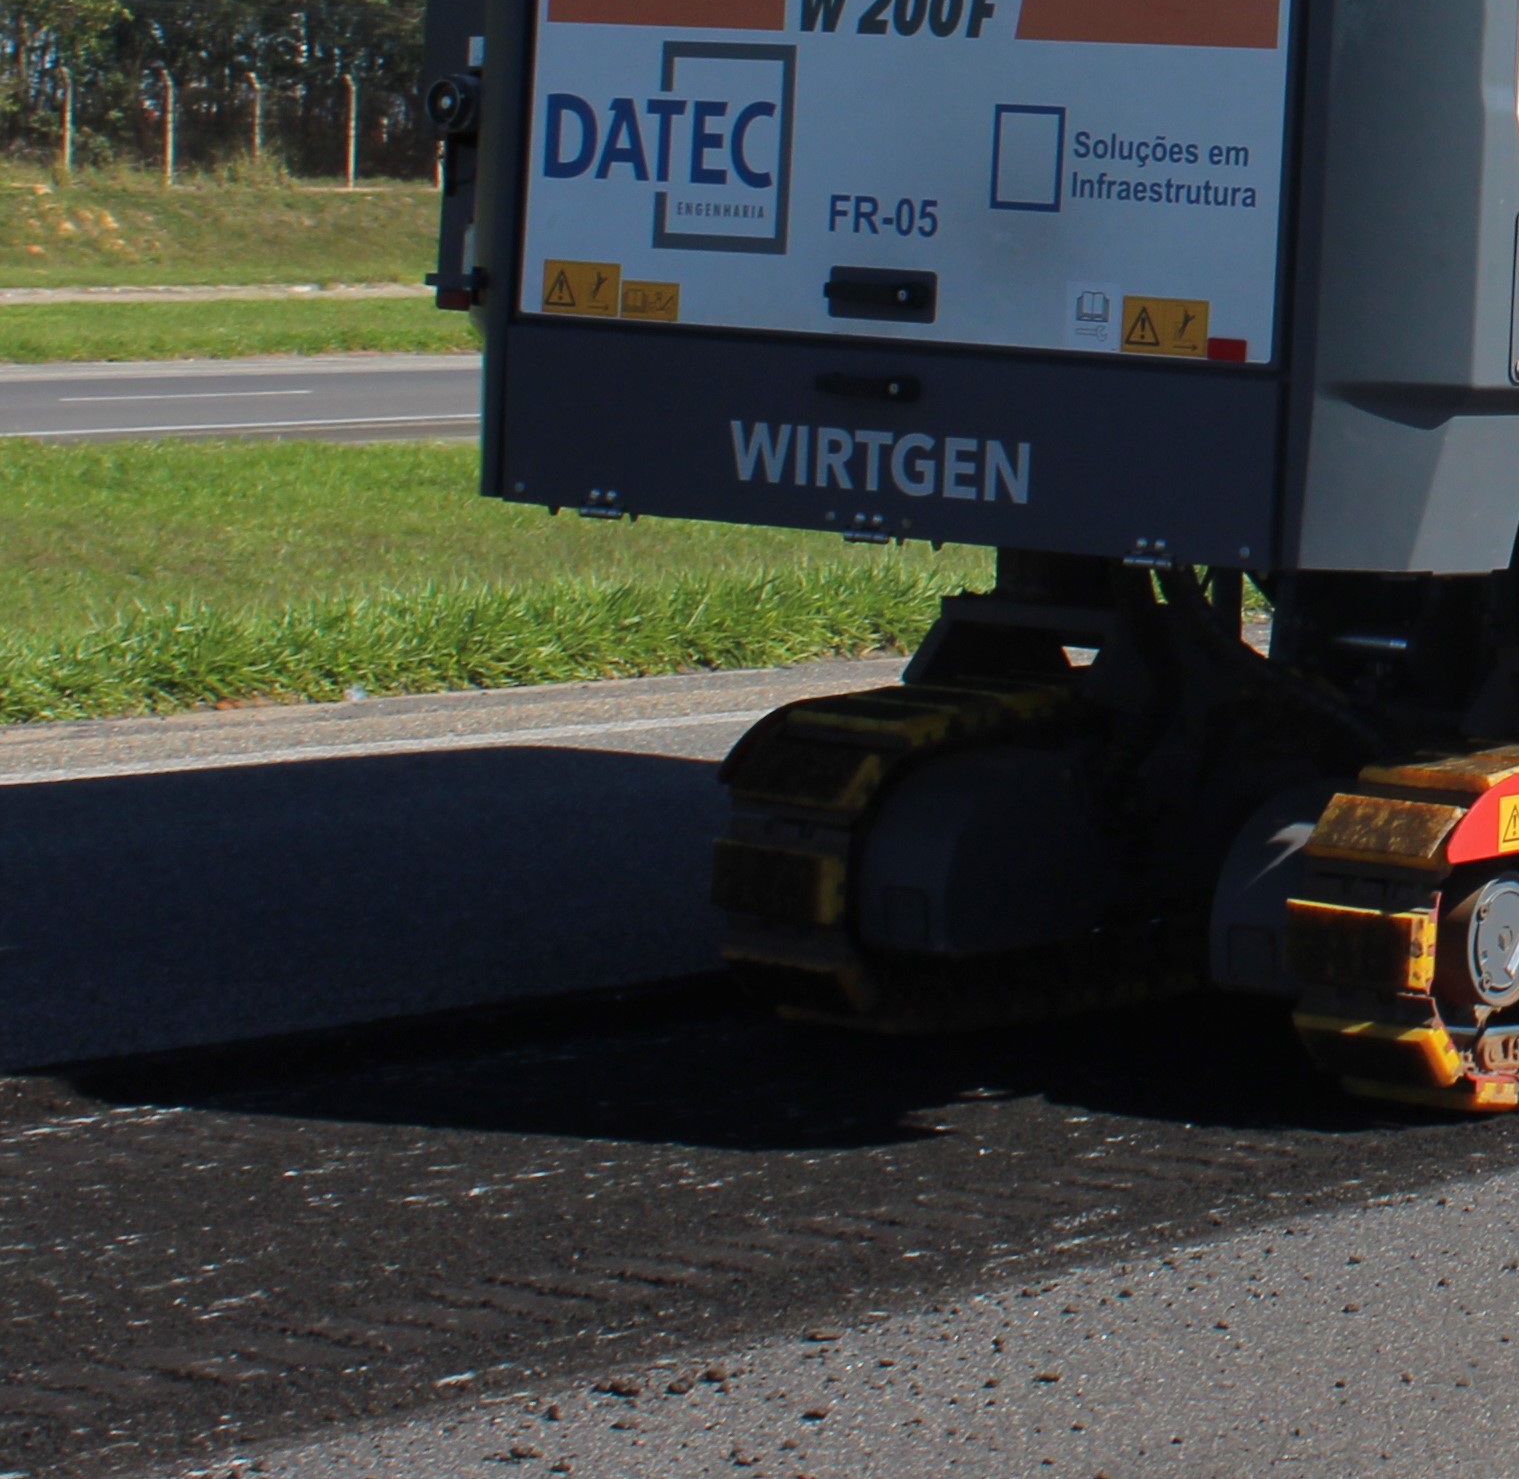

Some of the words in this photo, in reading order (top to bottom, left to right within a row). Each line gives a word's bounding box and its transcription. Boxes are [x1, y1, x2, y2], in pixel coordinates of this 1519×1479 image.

[543, 93, 777, 189] DATEC
[1073, 131, 1199, 168] Soluções
[1208, 144, 1249, 167] em
[1071, 171, 1257, 208] Infraestrutura
[676, 201, 765, 219] ENGENHARIA
[828, 194, 938, 238] FR-05
[730, 420, 1031, 505] WIRTGEN
